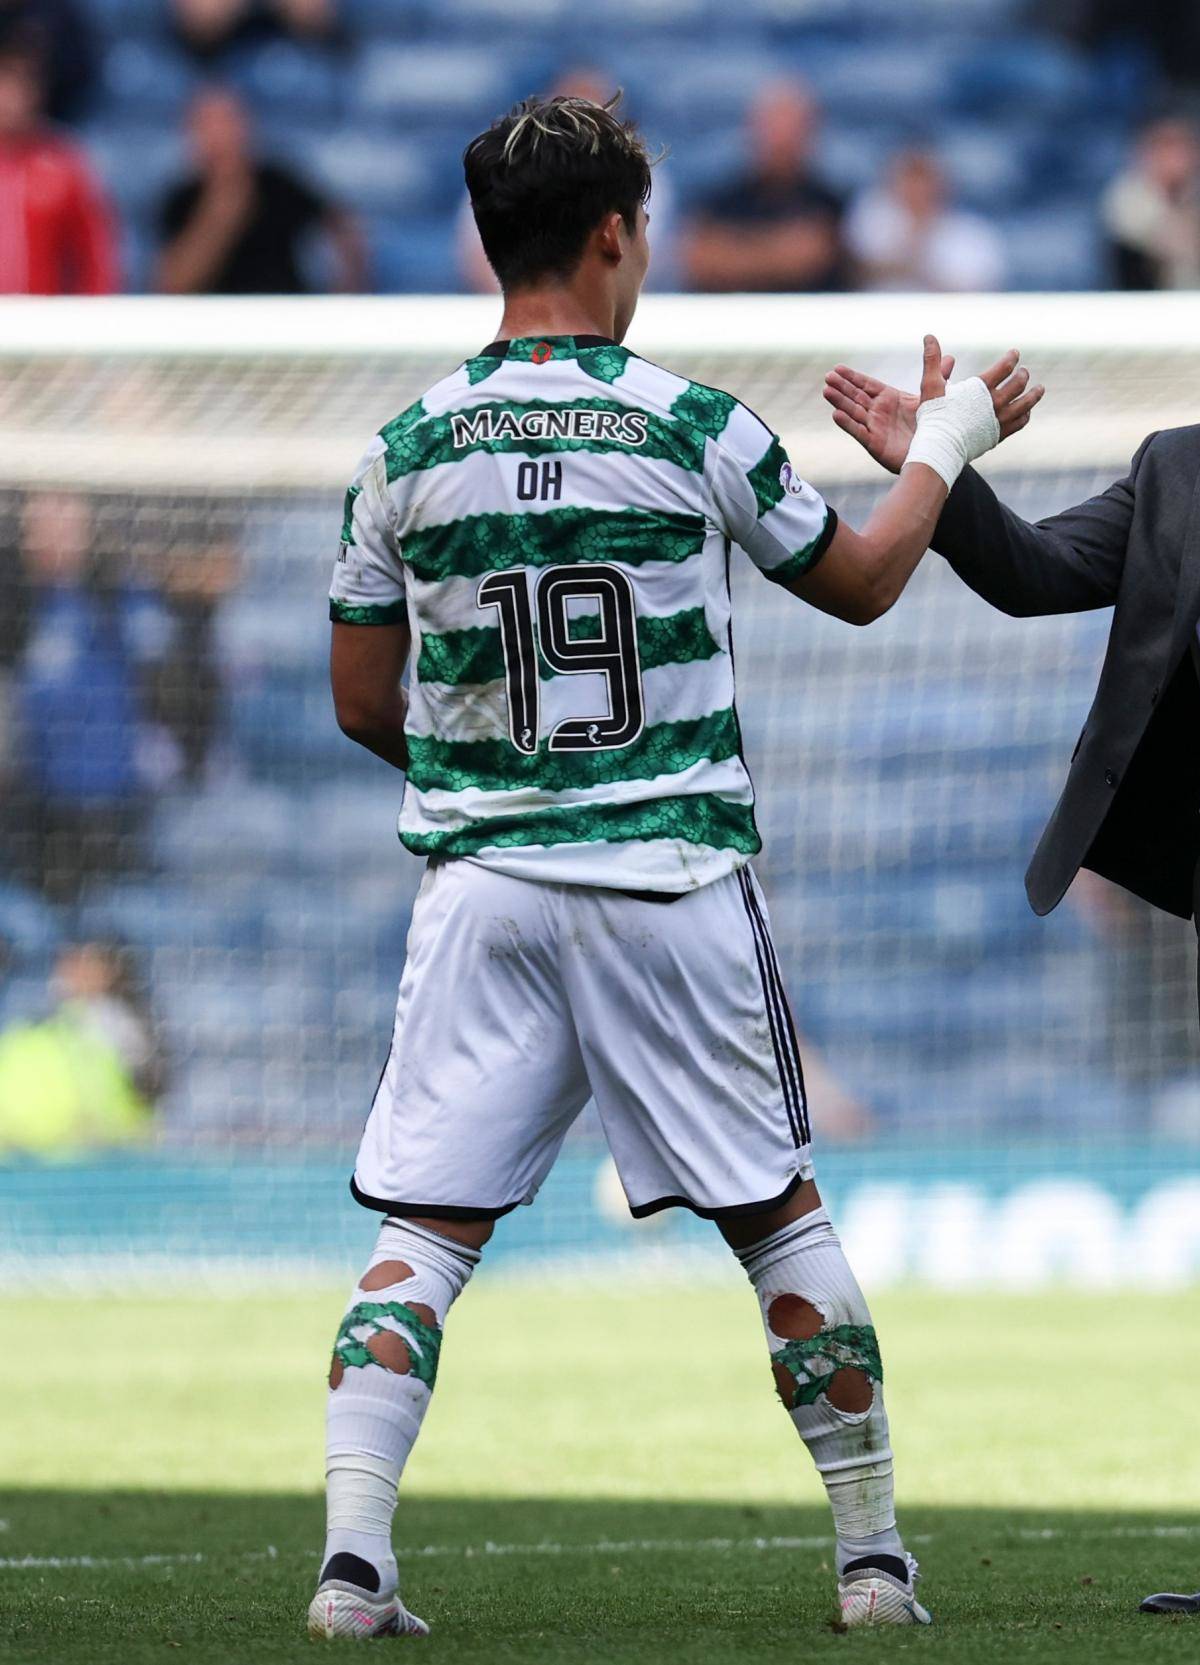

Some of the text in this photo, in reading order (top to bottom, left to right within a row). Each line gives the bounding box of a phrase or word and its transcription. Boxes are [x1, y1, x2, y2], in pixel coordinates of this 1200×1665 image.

[451, 410, 649, 448] MAGNERS
[517, 461, 562, 500] OH
[477, 563, 645, 755] 19
